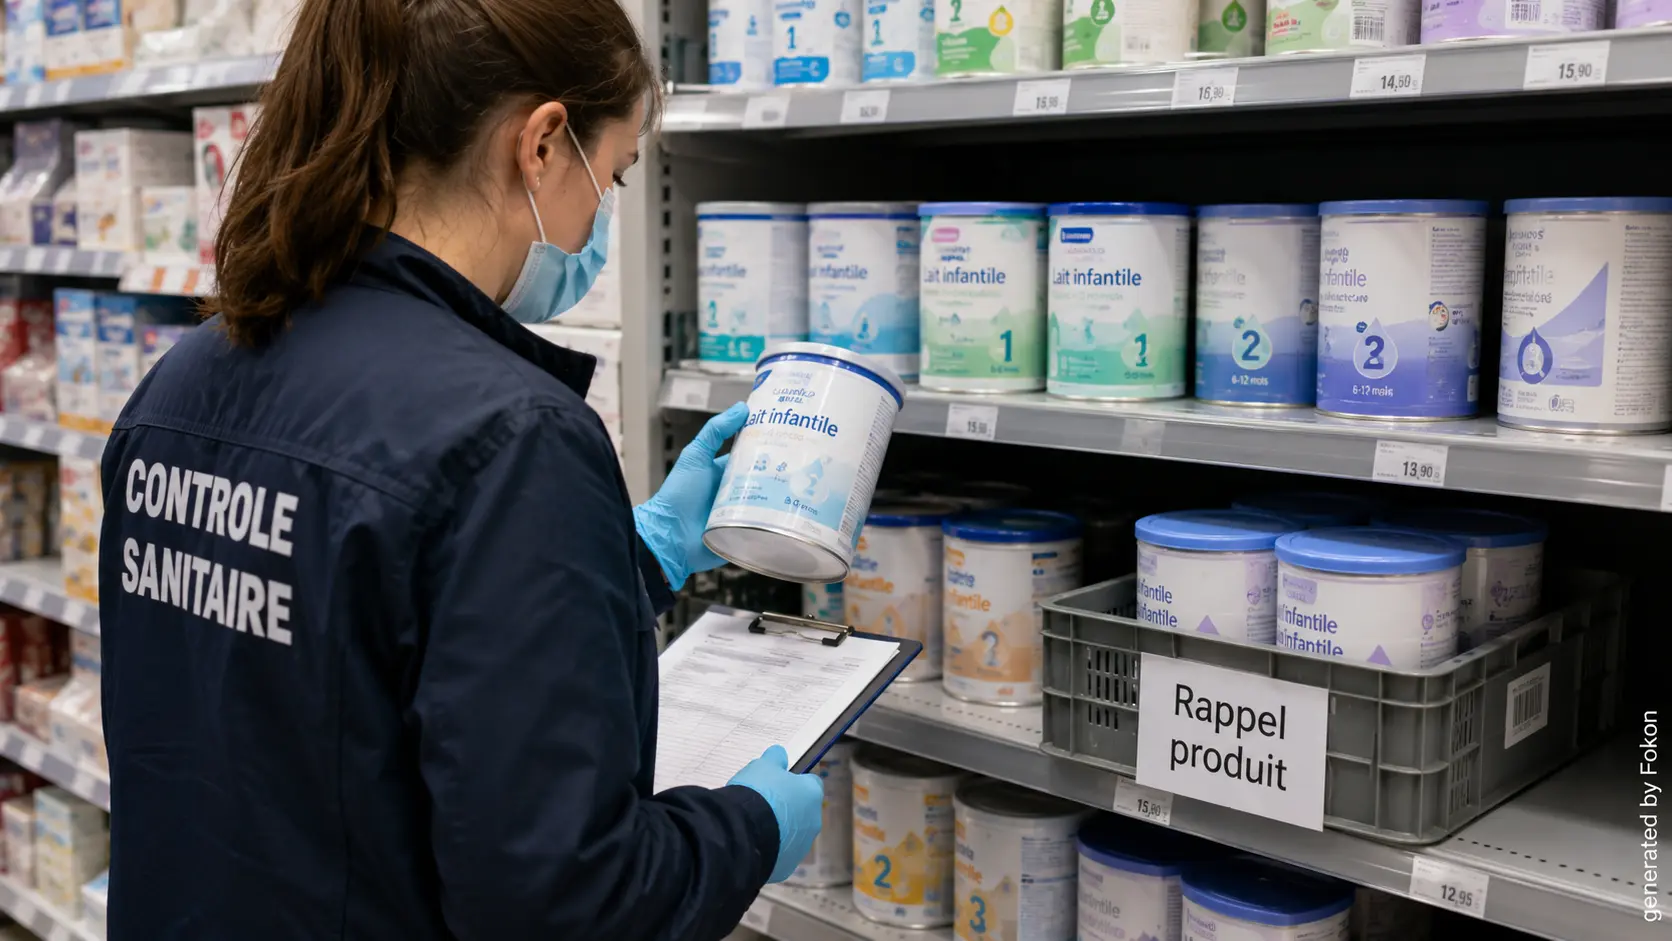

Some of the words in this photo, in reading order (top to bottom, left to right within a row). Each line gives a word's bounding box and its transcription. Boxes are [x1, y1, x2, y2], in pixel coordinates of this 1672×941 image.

[942, 266, 1007, 285] infantile
[1073, 267, 1142, 286] infantile
[999, 330, 1013, 362] 1
[1134, 333, 1148, 367] 1
[1241, 330, 1261, 362] 2
[1363, 335, 1385, 370] 2
[768, 407, 839, 437] infantile
[1403, 461, 1433, 480] 13,90
[125, 458, 299, 557] CONTROLE
[121, 537, 293, 646] SANITAIRE
[1174, 683, 1287, 740] Rappel
[1170, 738, 1288, 791] produit
[874, 855, 892, 889] 2
[1441, 884, 1473, 907] 12,95
[969, 896, 986, 933] 3
